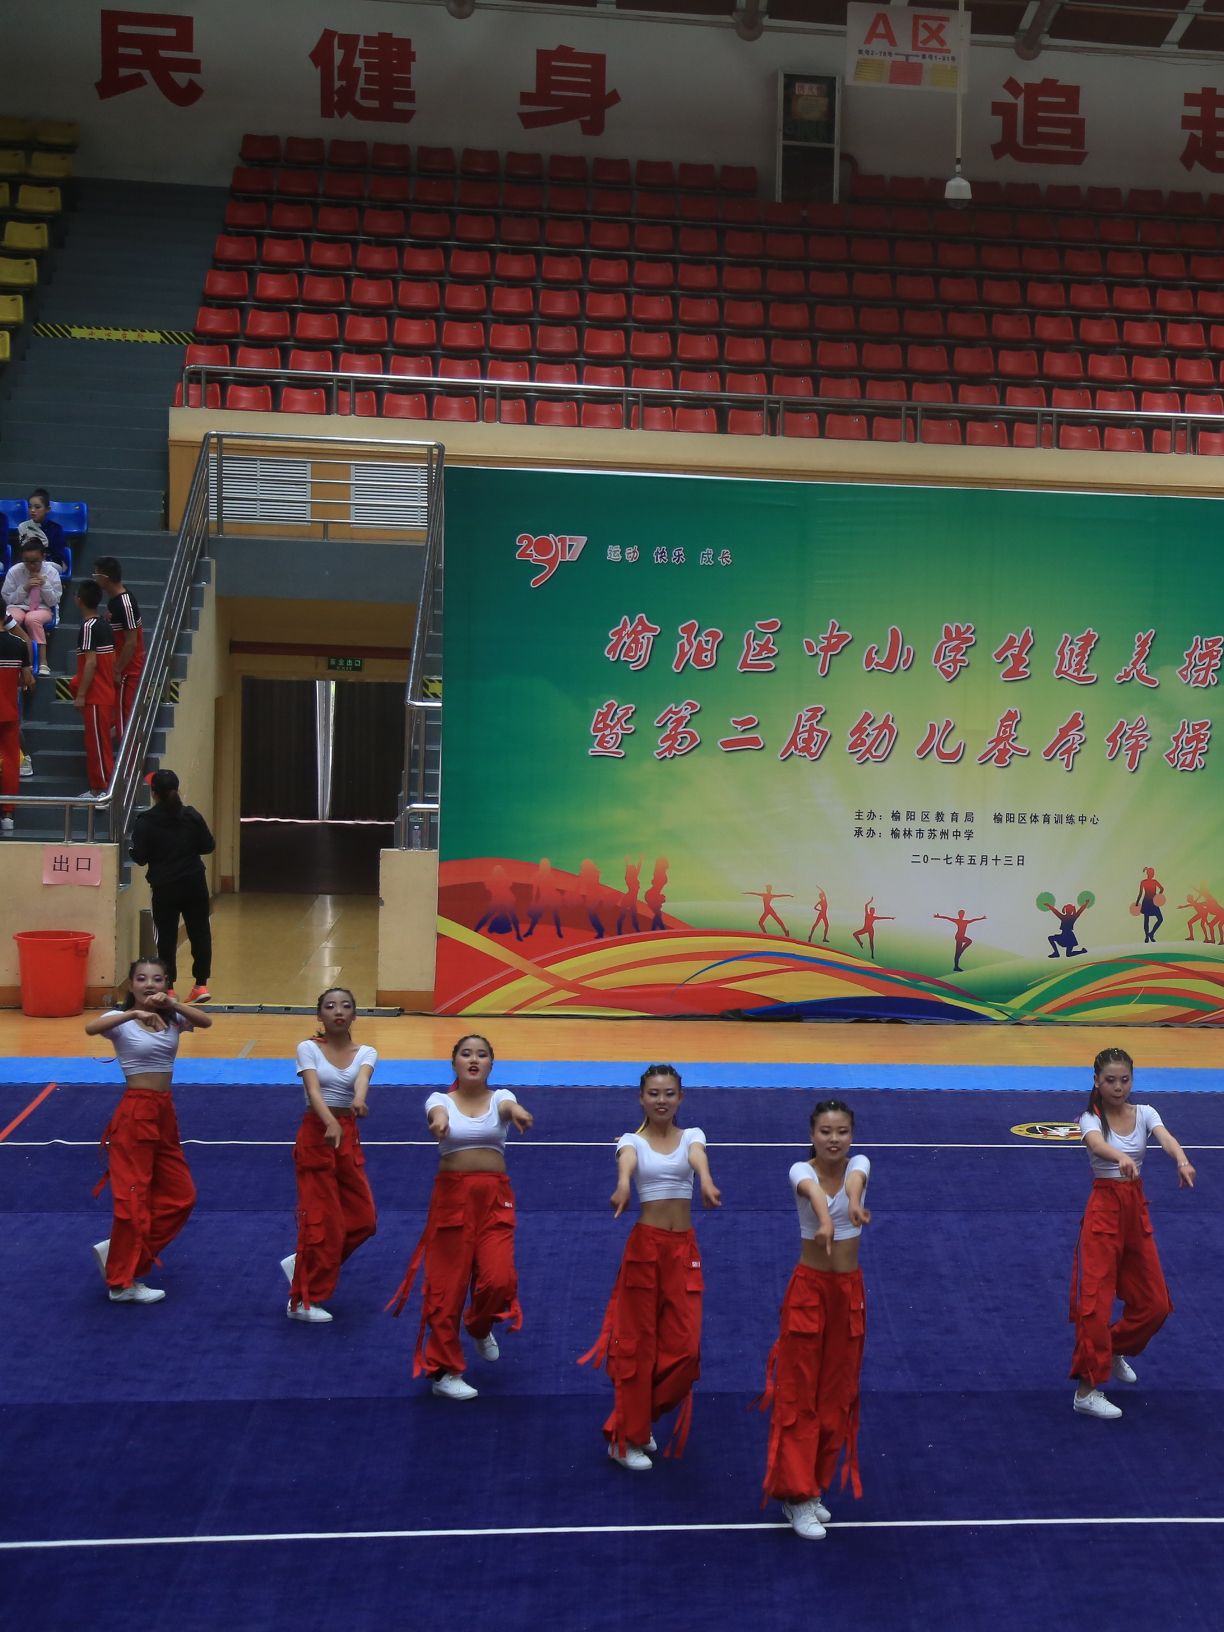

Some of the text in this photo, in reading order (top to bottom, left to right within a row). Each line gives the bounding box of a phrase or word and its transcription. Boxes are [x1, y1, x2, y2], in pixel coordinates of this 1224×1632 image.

[864, 12, 951, 54] A区
[516, 534, 587, 588] 2017
[607, 545, 732, 565] 运动 快乐 成长
[993, 812, 1100, 825] 榆阳区体育训练中心
[53, 855, 91, 872] 出口
